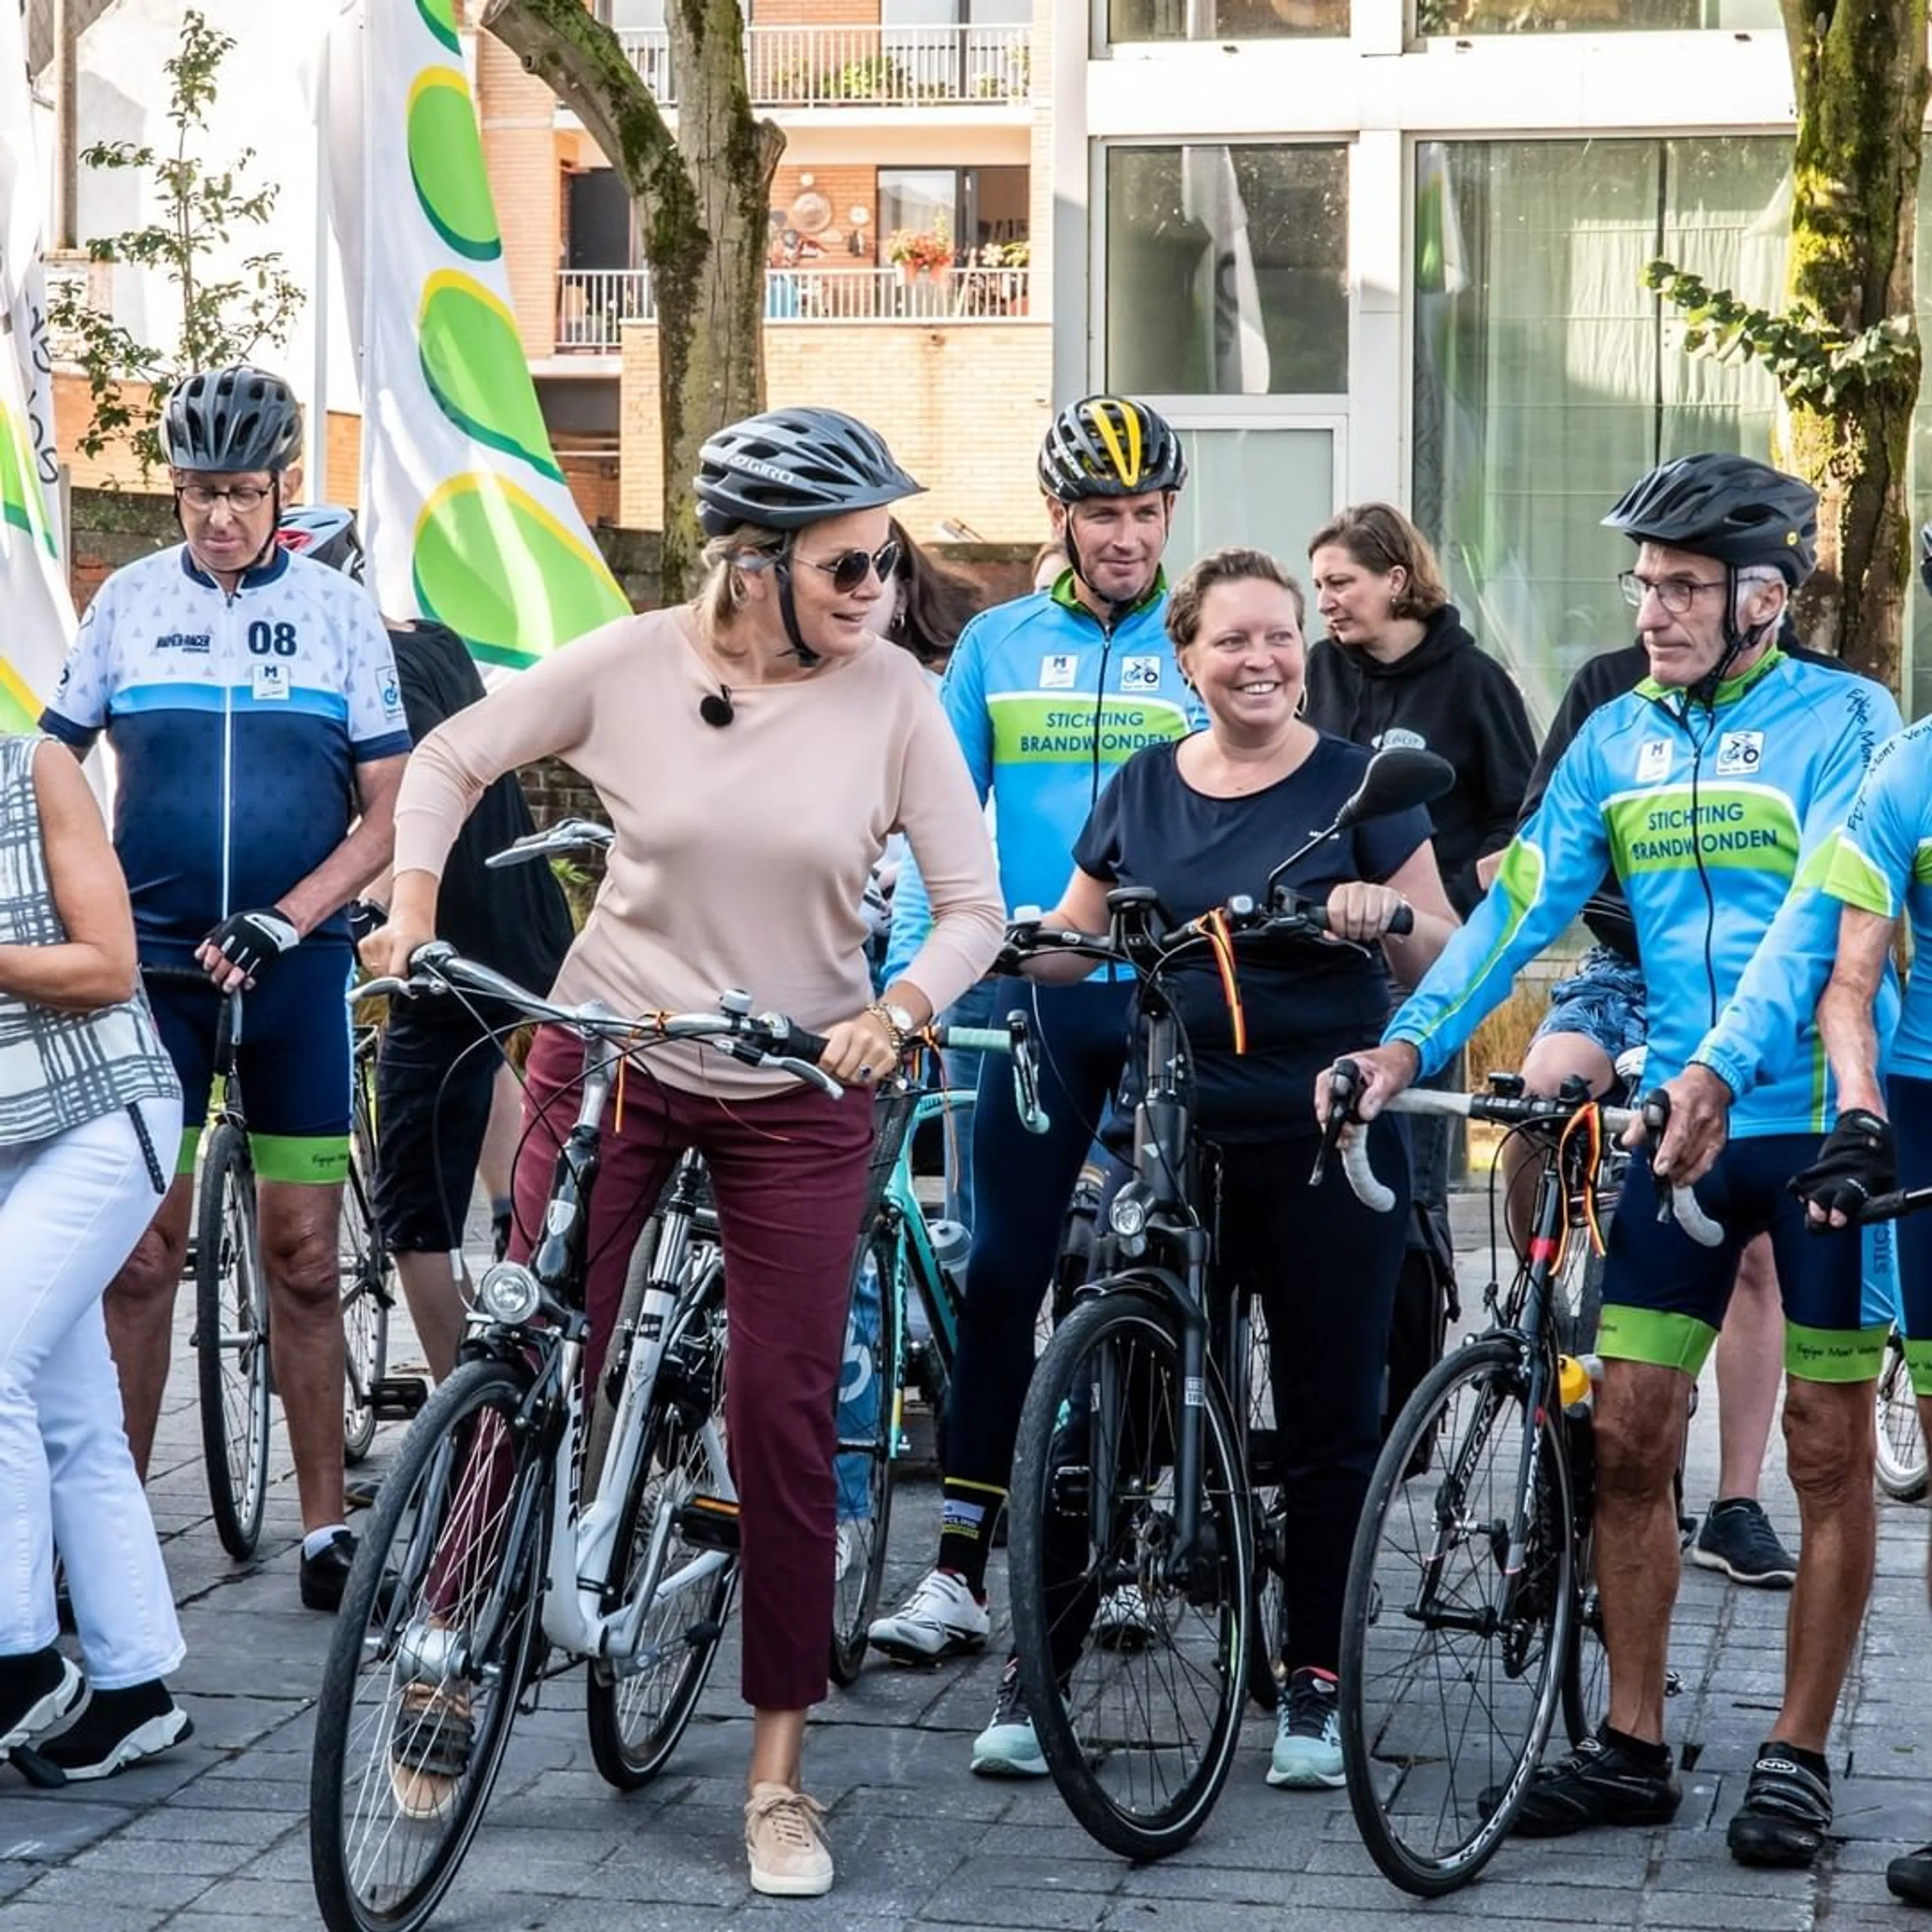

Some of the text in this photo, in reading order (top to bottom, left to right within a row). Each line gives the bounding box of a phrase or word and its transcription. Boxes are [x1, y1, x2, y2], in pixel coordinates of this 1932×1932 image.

[748, 458, 794, 484] GIRO
[249, 621, 297, 656] 08
[265, 666, 277, 677] M
[1046, 711, 1144, 728] STICHTING
[1648, 802, 1743, 831] STICHTING
[1632, 828, 1777, 859] BRANDWONDEN
[567, 1362, 583, 1531] TREK
